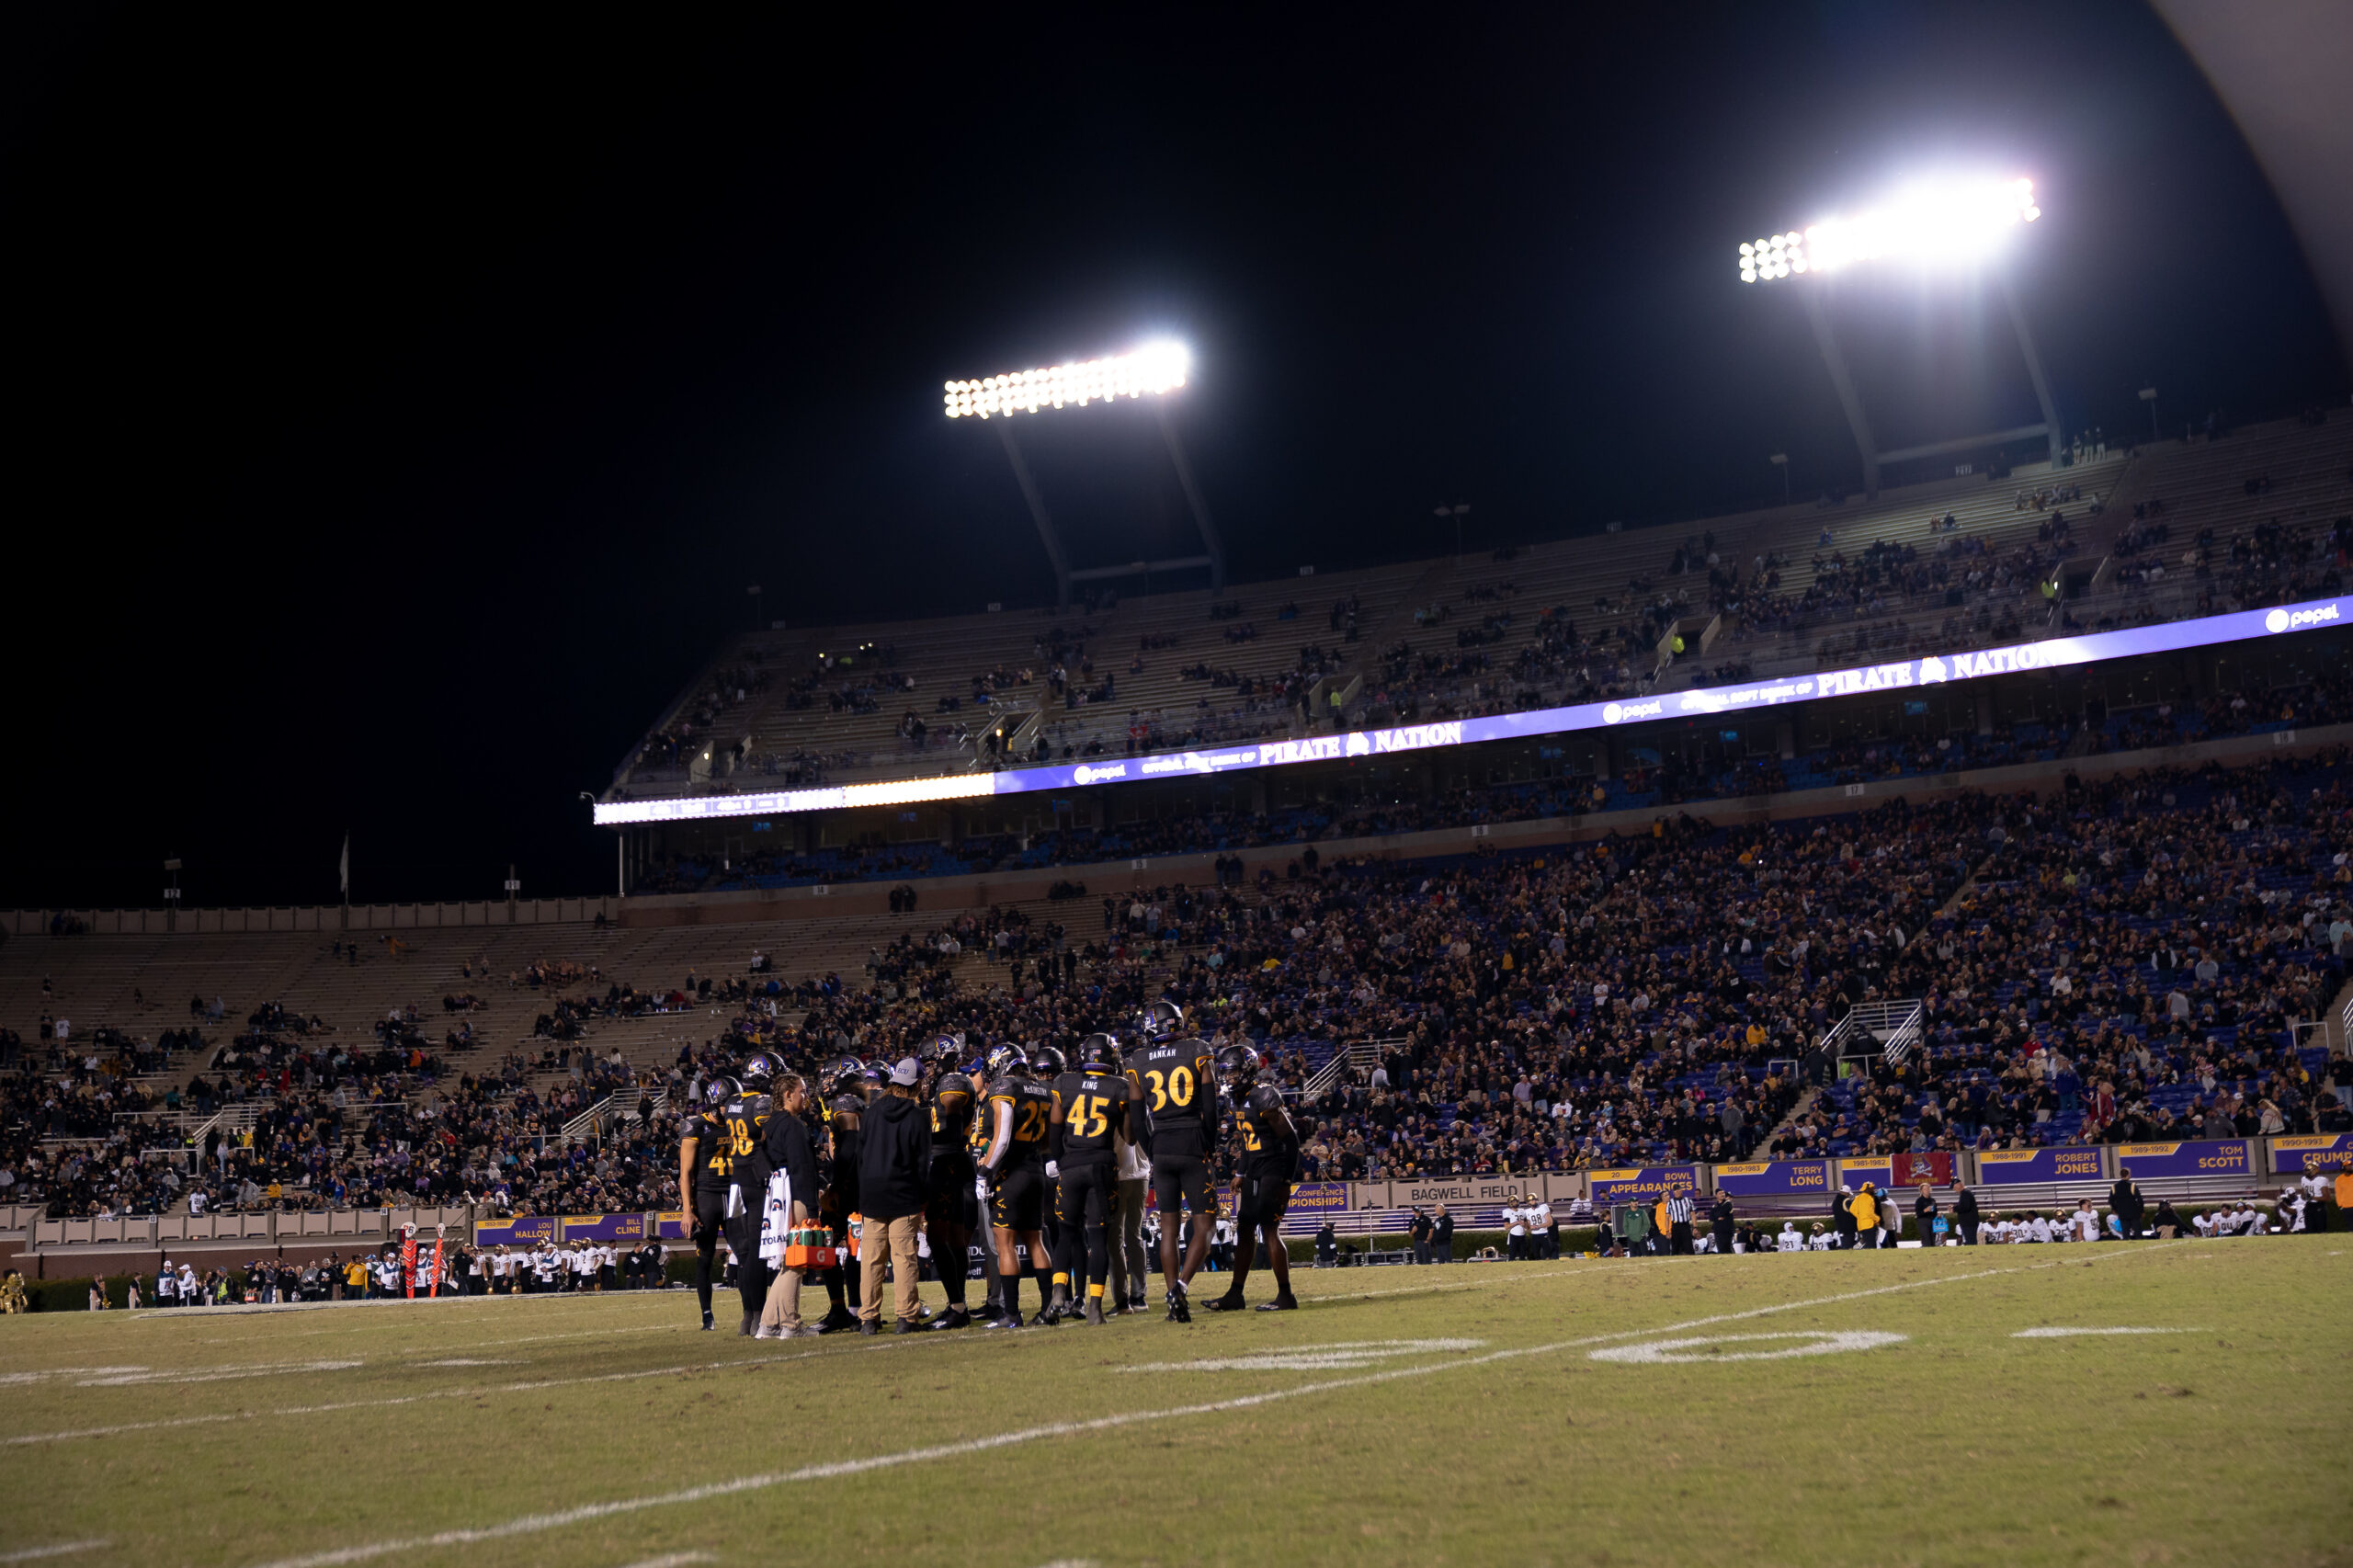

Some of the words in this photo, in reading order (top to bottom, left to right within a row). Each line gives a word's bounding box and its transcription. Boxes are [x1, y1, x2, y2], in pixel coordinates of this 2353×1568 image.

[2290, 603, 2339, 628] pepsi
[1817, 663, 1912, 697] PIRATE
[1259, 737, 1340, 765] PIRATE
[1374, 722, 1461, 752] NATION
[1082, 1080, 1098, 1090] KING
[1145, 1066, 1194, 1112] 30
[1015, 1100, 1051, 1142] 25
[1067, 1094, 1110, 1138] 45
[2281, 1139, 2324, 1147] 1990-1993
[2219, 1146, 2243, 1155] TOM
[2054, 1153, 2097, 1163] ROBERT
[2199, 1156, 2244, 1168] SCOTT
[1792, 1166, 1823, 1176] TERRY
[2054, 1163, 2097, 1174] JONES
[1665, 1173, 1692, 1181] BOWL
[1790, 1176, 1823, 1187] LONG
[1412, 1187, 1473, 1200] BAGWELL
[1481, 1186, 1518, 1198] FIELD
[1530, 1214, 1542, 1225] 98
[515, 1230, 551, 1238] HALLOW
[615, 1226, 641, 1234] CLINE
[816, 1250, 825, 1263] G
